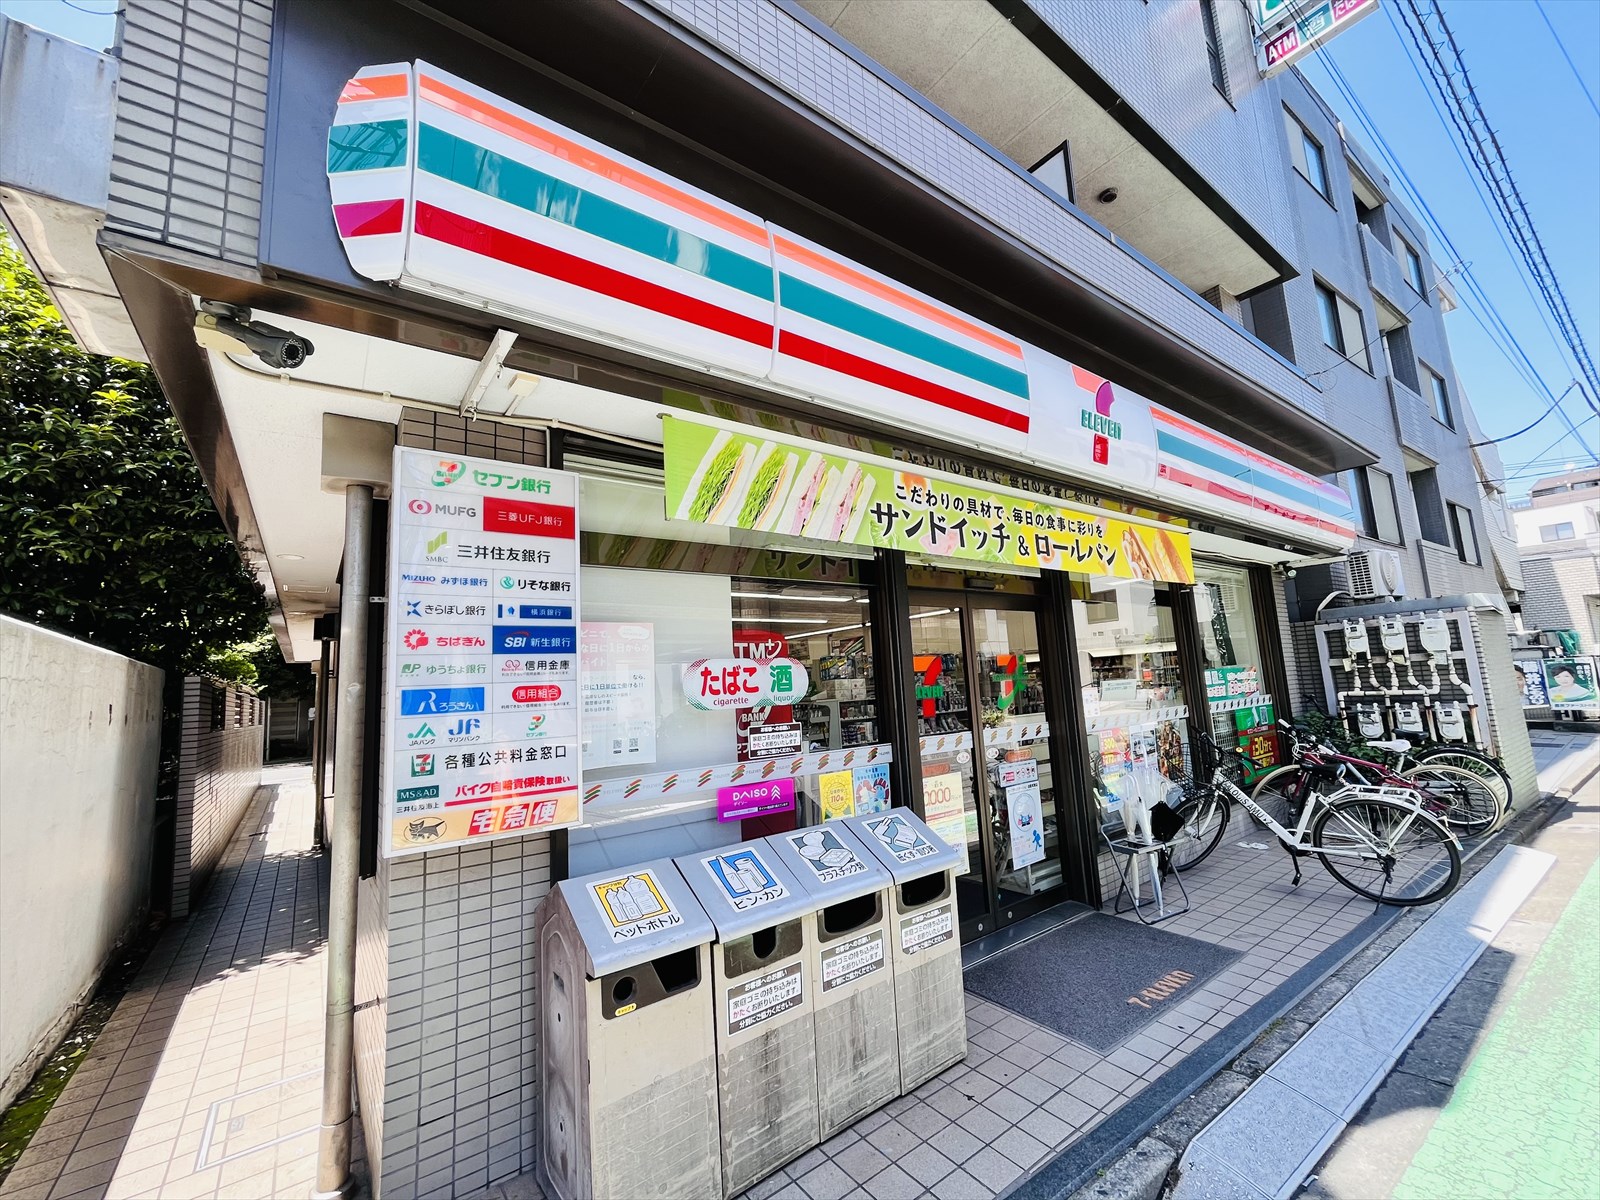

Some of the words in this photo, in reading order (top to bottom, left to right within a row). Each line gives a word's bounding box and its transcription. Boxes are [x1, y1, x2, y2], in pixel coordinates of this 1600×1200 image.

[1269, 32, 1297, 62] ATM
[472, 469, 552, 494] セブン銀行
[435, 504, 476, 518] MUFG
[497, 511, 562, 527] 三菱UFJ銀行
[896, 485, 1103, 538] こだわりの具材で、毎日の食事に彩りを
[870, 503, 1011, 554] サンドイッチ
[1018, 535, 1030, 557] &
[1035, 534, 1117, 566] ロールパン
[457, 544, 551, 564] 三井住友銀行
[402, 574, 436, 582] MIZUHO
[440, 577, 488, 587] みずほ銀行
[518, 579, 571, 592] りそな銀行
[424, 604, 486, 616] きらぼし銀行
[531, 608, 562, 616] 横浜銀行
[436, 636, 486, 648] ちばぎん
[504, 636, 526, 648] SBI
[530, 637, 571, 648] 新生銀行
[426, 664, 487, 675] ゆうちょ銀行
[525, 660, 570, 671] 信用金庫
[701, 665, 759, 697] たばこ
[770, 665, 793, 693] 酒
[516, 688, 558, 700] 信用組合
[713, 697, 749, 707] cigarette
[773, 694, 795, 703] liquor
[439, 701, 474, 712] ろうきん
[741, 713, 766, 723] BANK
[409, 738, 436, 747] JAバンク
[448, 735, 481, 743] マリンバンク
[444, 745, 567, 771] 各種公共料金窓口
[455, 775, 570, 797] バイク自賠責保険取扱い
[400, 788, 437, 799] MS&AD
[733, 788, 768, 801] DAISO
[472, 800, 557, 833] 宅急便
[818, 863, 866, 882] プラスチック類
[733, 887, 784, 910] ビン・カン
[613, 914, 680, 938] ペットボトル
[732, 977, 798, 1010] 家庭ゴミの持ち込みは
[733, 987, 799, 1019] かたくお断りいたします。
